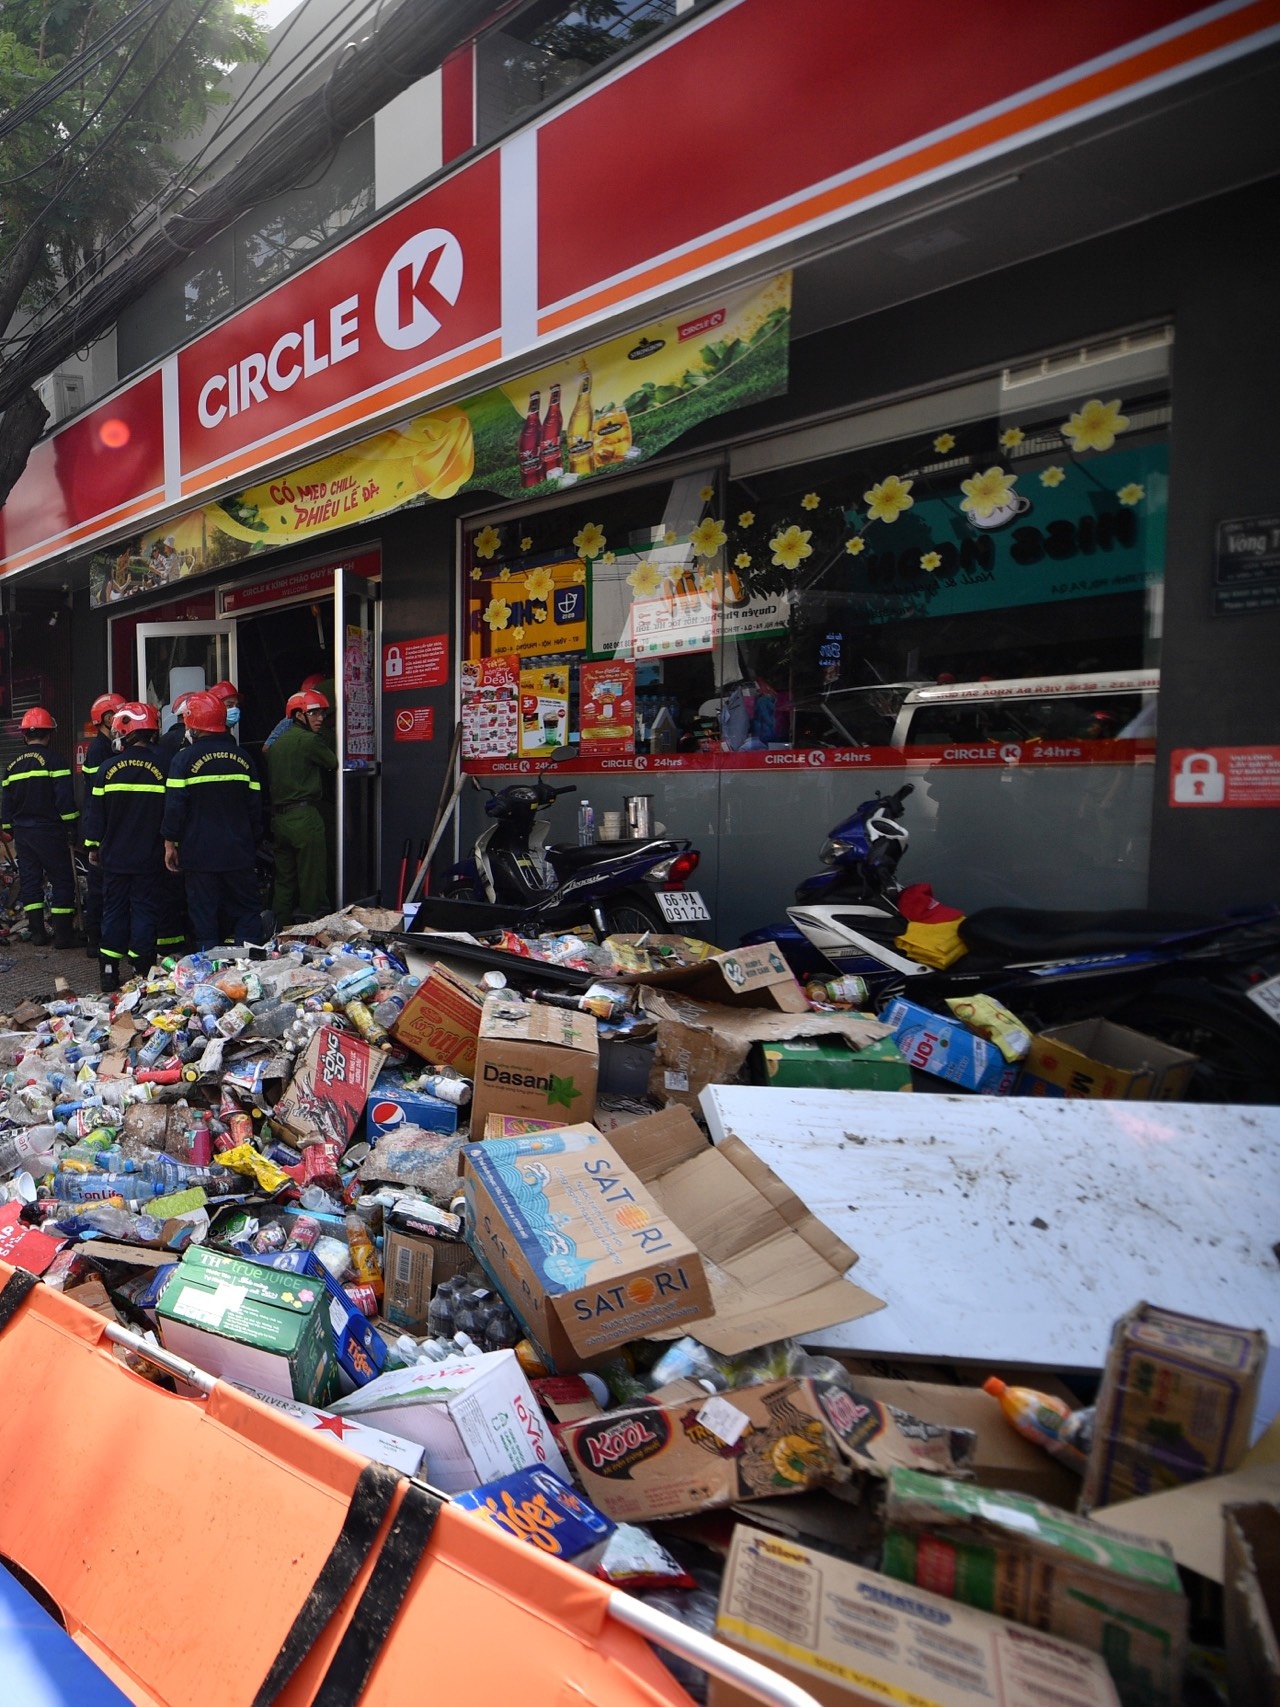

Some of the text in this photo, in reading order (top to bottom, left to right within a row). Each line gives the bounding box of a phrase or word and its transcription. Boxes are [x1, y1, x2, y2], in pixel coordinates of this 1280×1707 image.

[198, 235, 461, 428] CIRCLE K
[269, 479, 295, 505] CÓ
[330, 476, 357, 495] CHILL
[294, 499, 340, 529] PHIÊU
[484, 671, 514, 685] Deals
[492, 762, 519, 772] CIRCLE
[601, 756, 682, 770] CIRCLE K 24hrs
[765, 750, 871, 766] CIRCLE K 24hrs
[944, 744, 1081, 763] CIRCLE K 24hrs
[665, 906, 708, 921] 091.22
[483, 1065, 555, 1091] Dasani
[584, 1159, 673, 1253] SATORI
[201, 1253, 222, 1268] TH
[231, 1260, 263, 1279] true
[263, 1269, 303, 1290] JUICE
[574, 1268, 690, 1322] SATORI
[349, 1338, 373, 1378] Tiger
[254, 1392, 290, 1410] SILVER
[587, 1421, 657, 1468] KOOL
